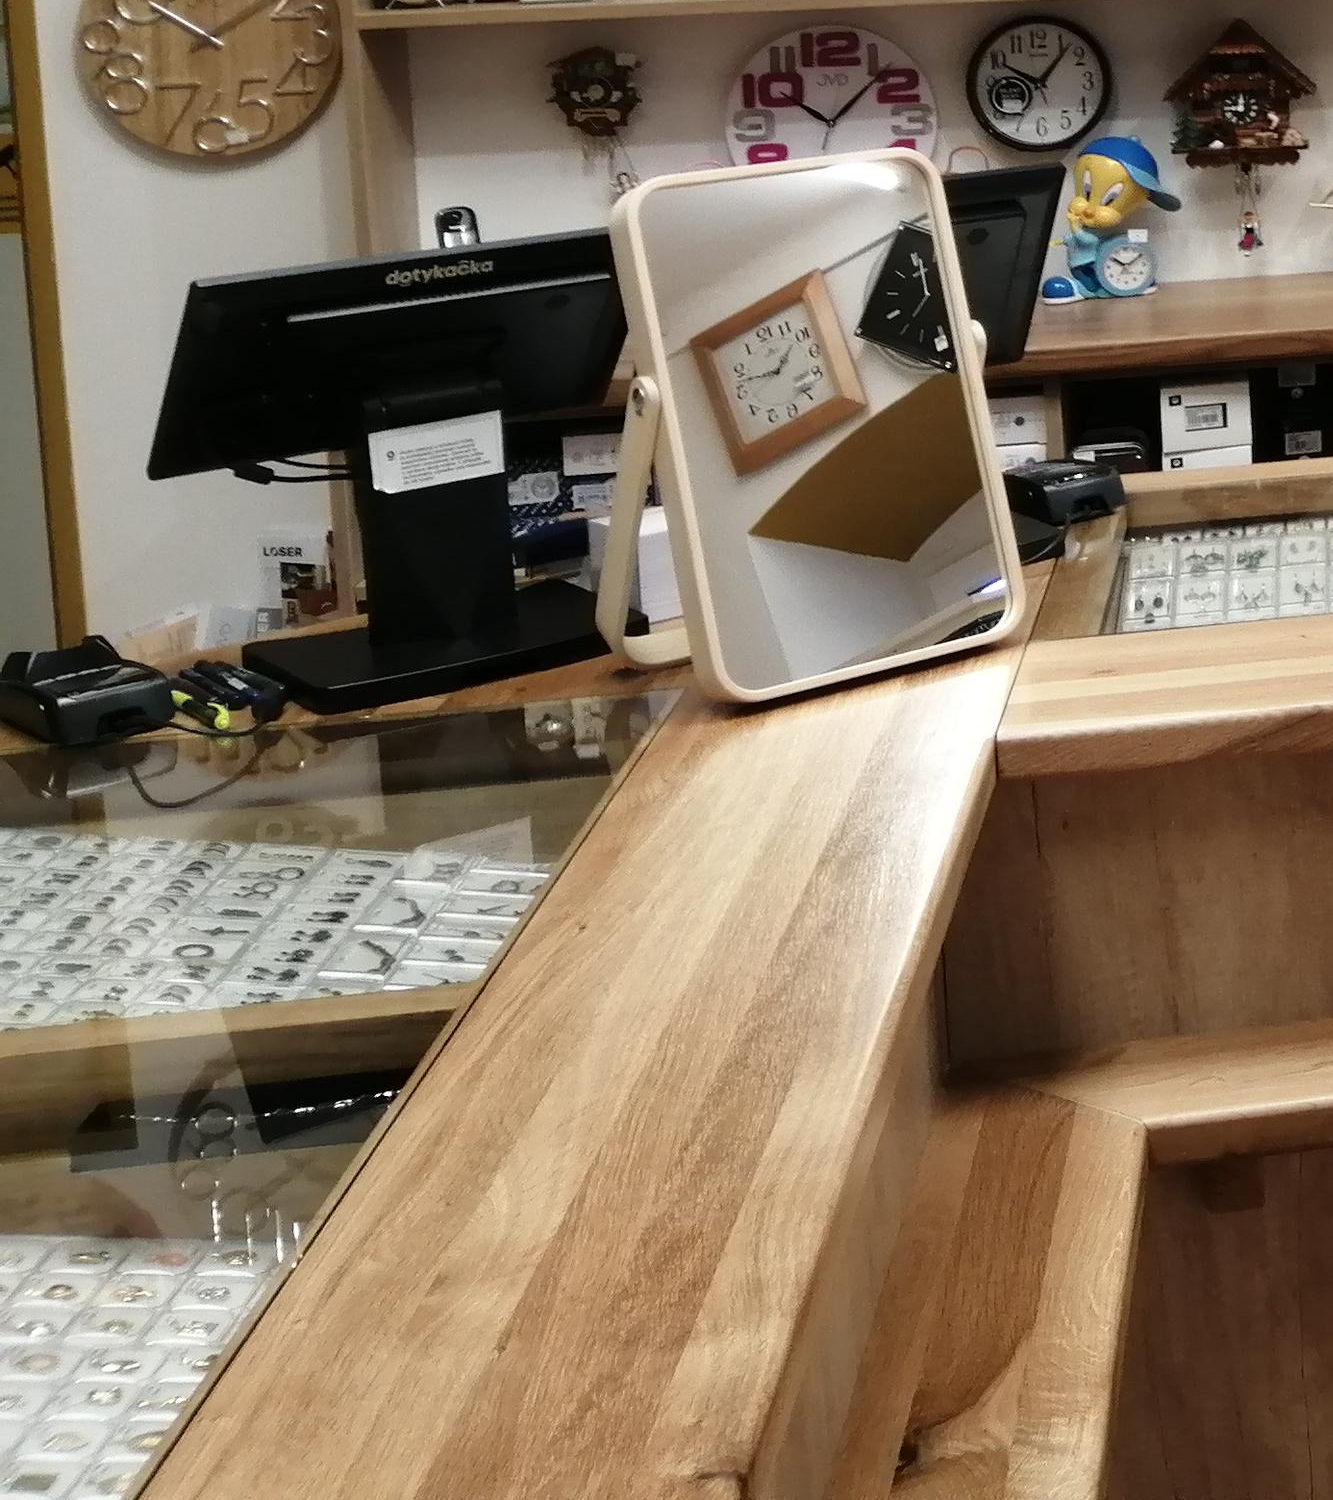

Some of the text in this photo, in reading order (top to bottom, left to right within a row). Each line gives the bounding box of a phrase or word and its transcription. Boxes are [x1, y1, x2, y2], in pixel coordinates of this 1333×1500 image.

[299, 4, 333, 65] 3
[1011, 36, 1022, 53] 11
[1030, 29, 1046, 48] 12
[770, 46, 795, 73] 11
[801, 31, 861, 67] 12
[867, 43, 878, 76] 1
[990, 51, 1005, 69] 10
[1074, 46, 1085, 66] 2
[105, 52, 148, 115] 8
[273, 59, 316, 109] 4
[743, 72, 805, 108] 10
[817, 74, 848, 87] JVD
[877, 68, 921, 104] 2
[1082, 71, 1094, 91] 3
[155, 82, 201, 146] 7
[891, 103, 934, 136] 3
[1061, 110, 1071, 129] 5
[1078, 97, 1086, 116] 4
[733, 108, 775, 142] 9
[1036, 117, 1048, 136] 6
[385, 260, 493, 287] dotykačka
